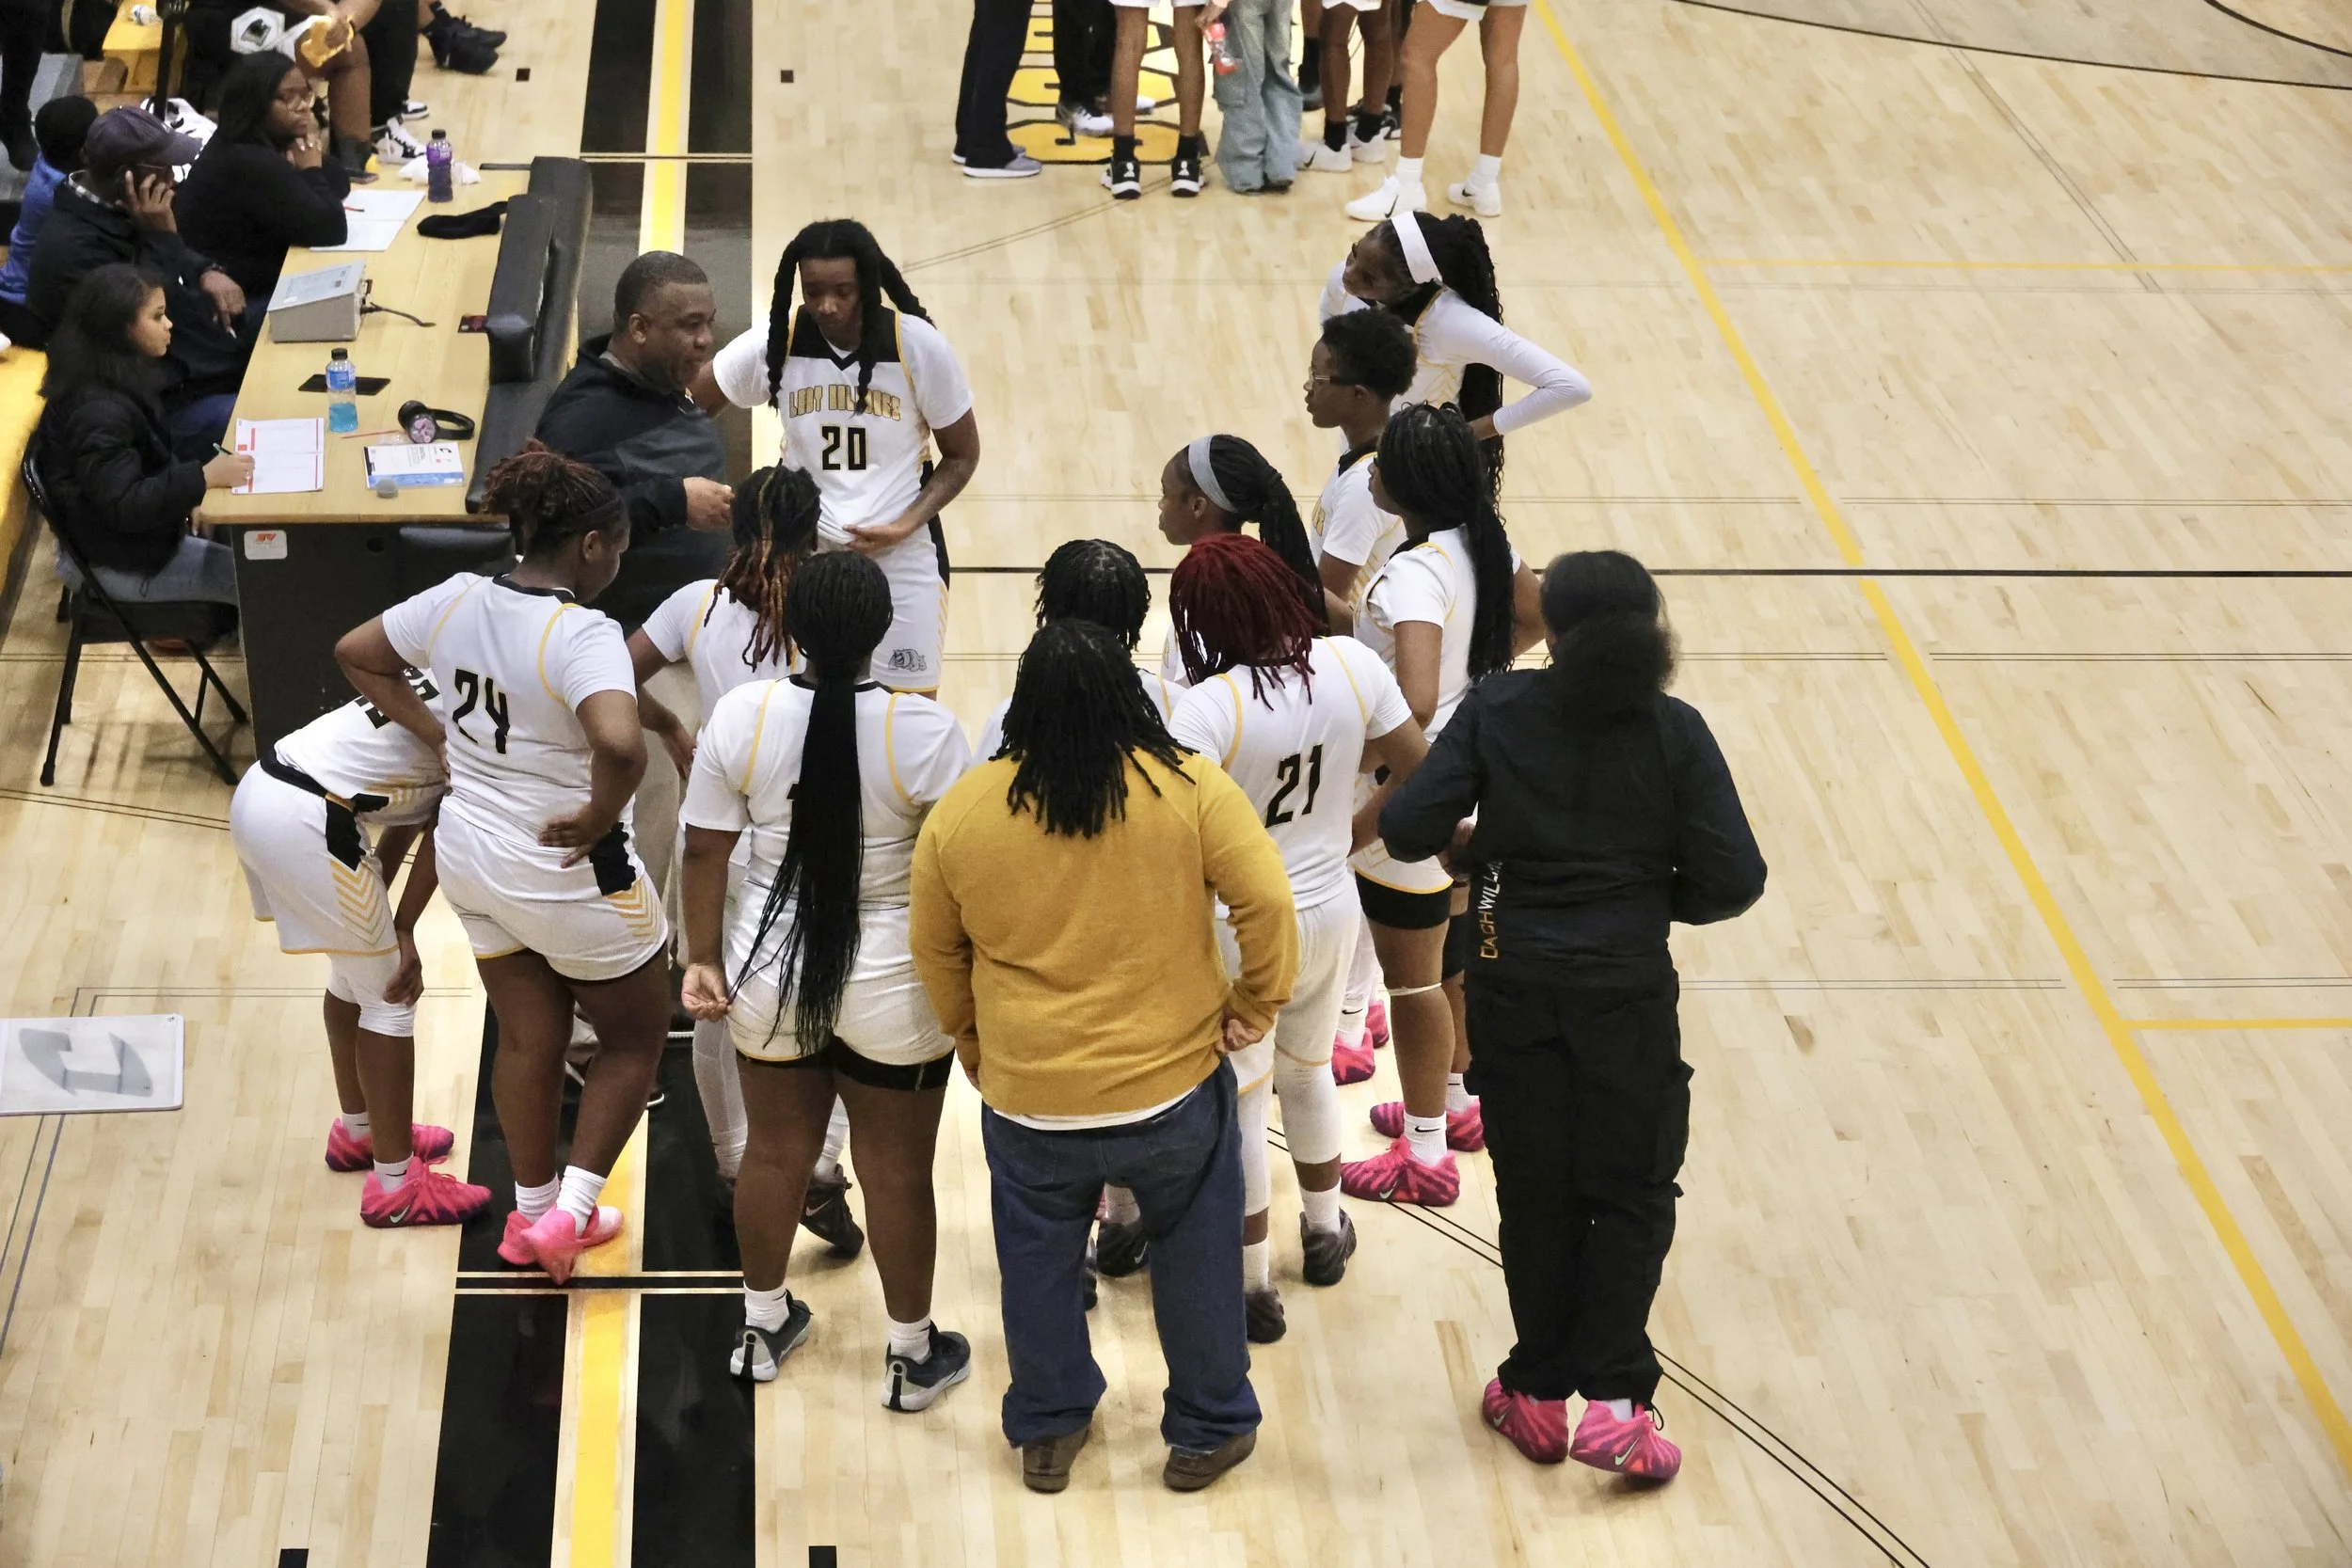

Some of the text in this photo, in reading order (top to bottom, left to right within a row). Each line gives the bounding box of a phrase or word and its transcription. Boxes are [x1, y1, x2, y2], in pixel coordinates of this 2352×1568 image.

[821, 425, 866, 470] 20
[453, 668, 510, 754] 24
[1264, 744, 1324, 828] 21
